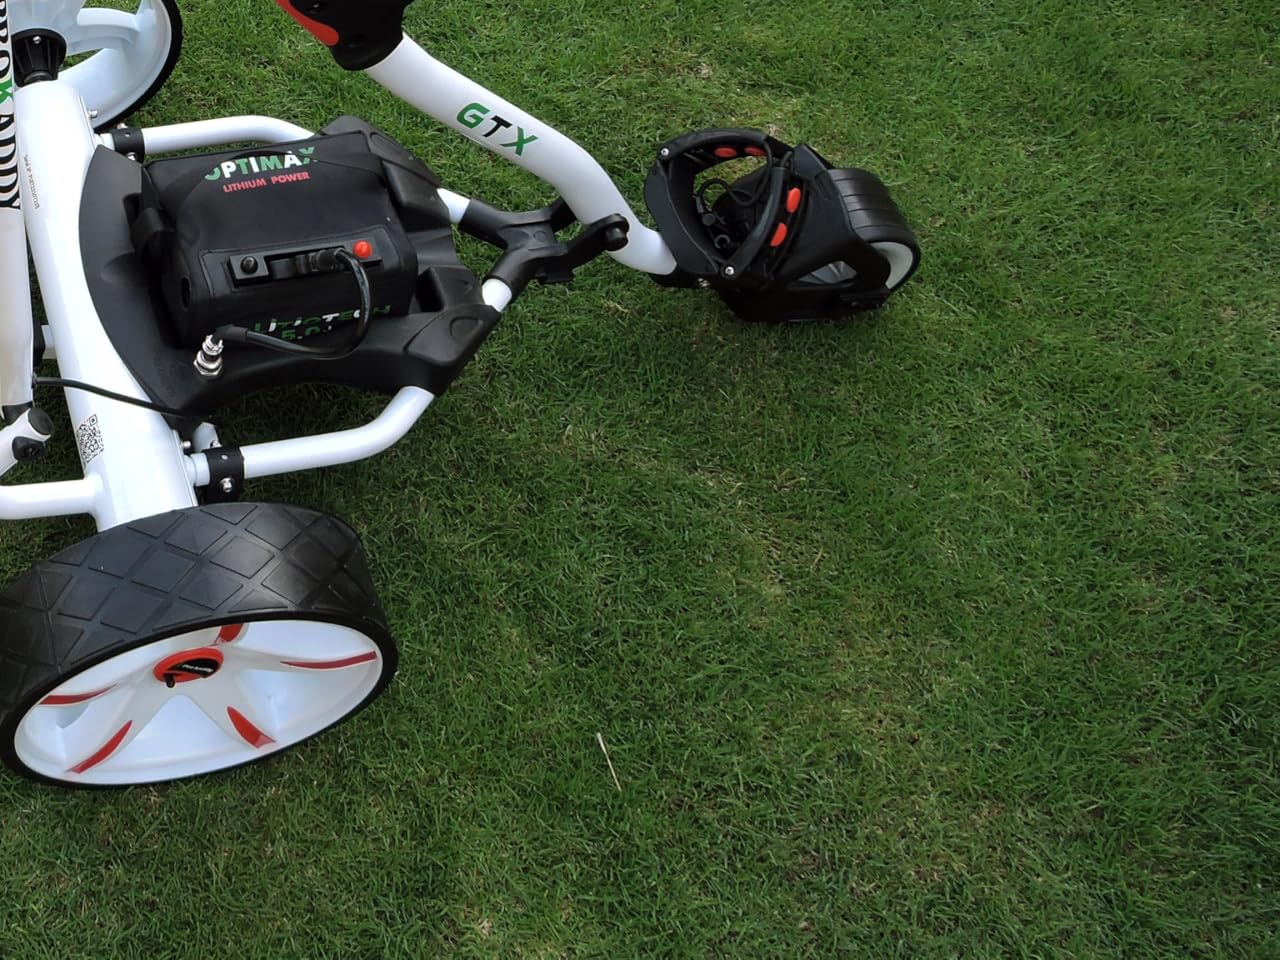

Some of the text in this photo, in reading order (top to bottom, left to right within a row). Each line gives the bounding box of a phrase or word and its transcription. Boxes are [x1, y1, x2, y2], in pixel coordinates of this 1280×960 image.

[457, 102, 539, 156] GTX
[223, 171, 311, 193] LITHIUM POWER
